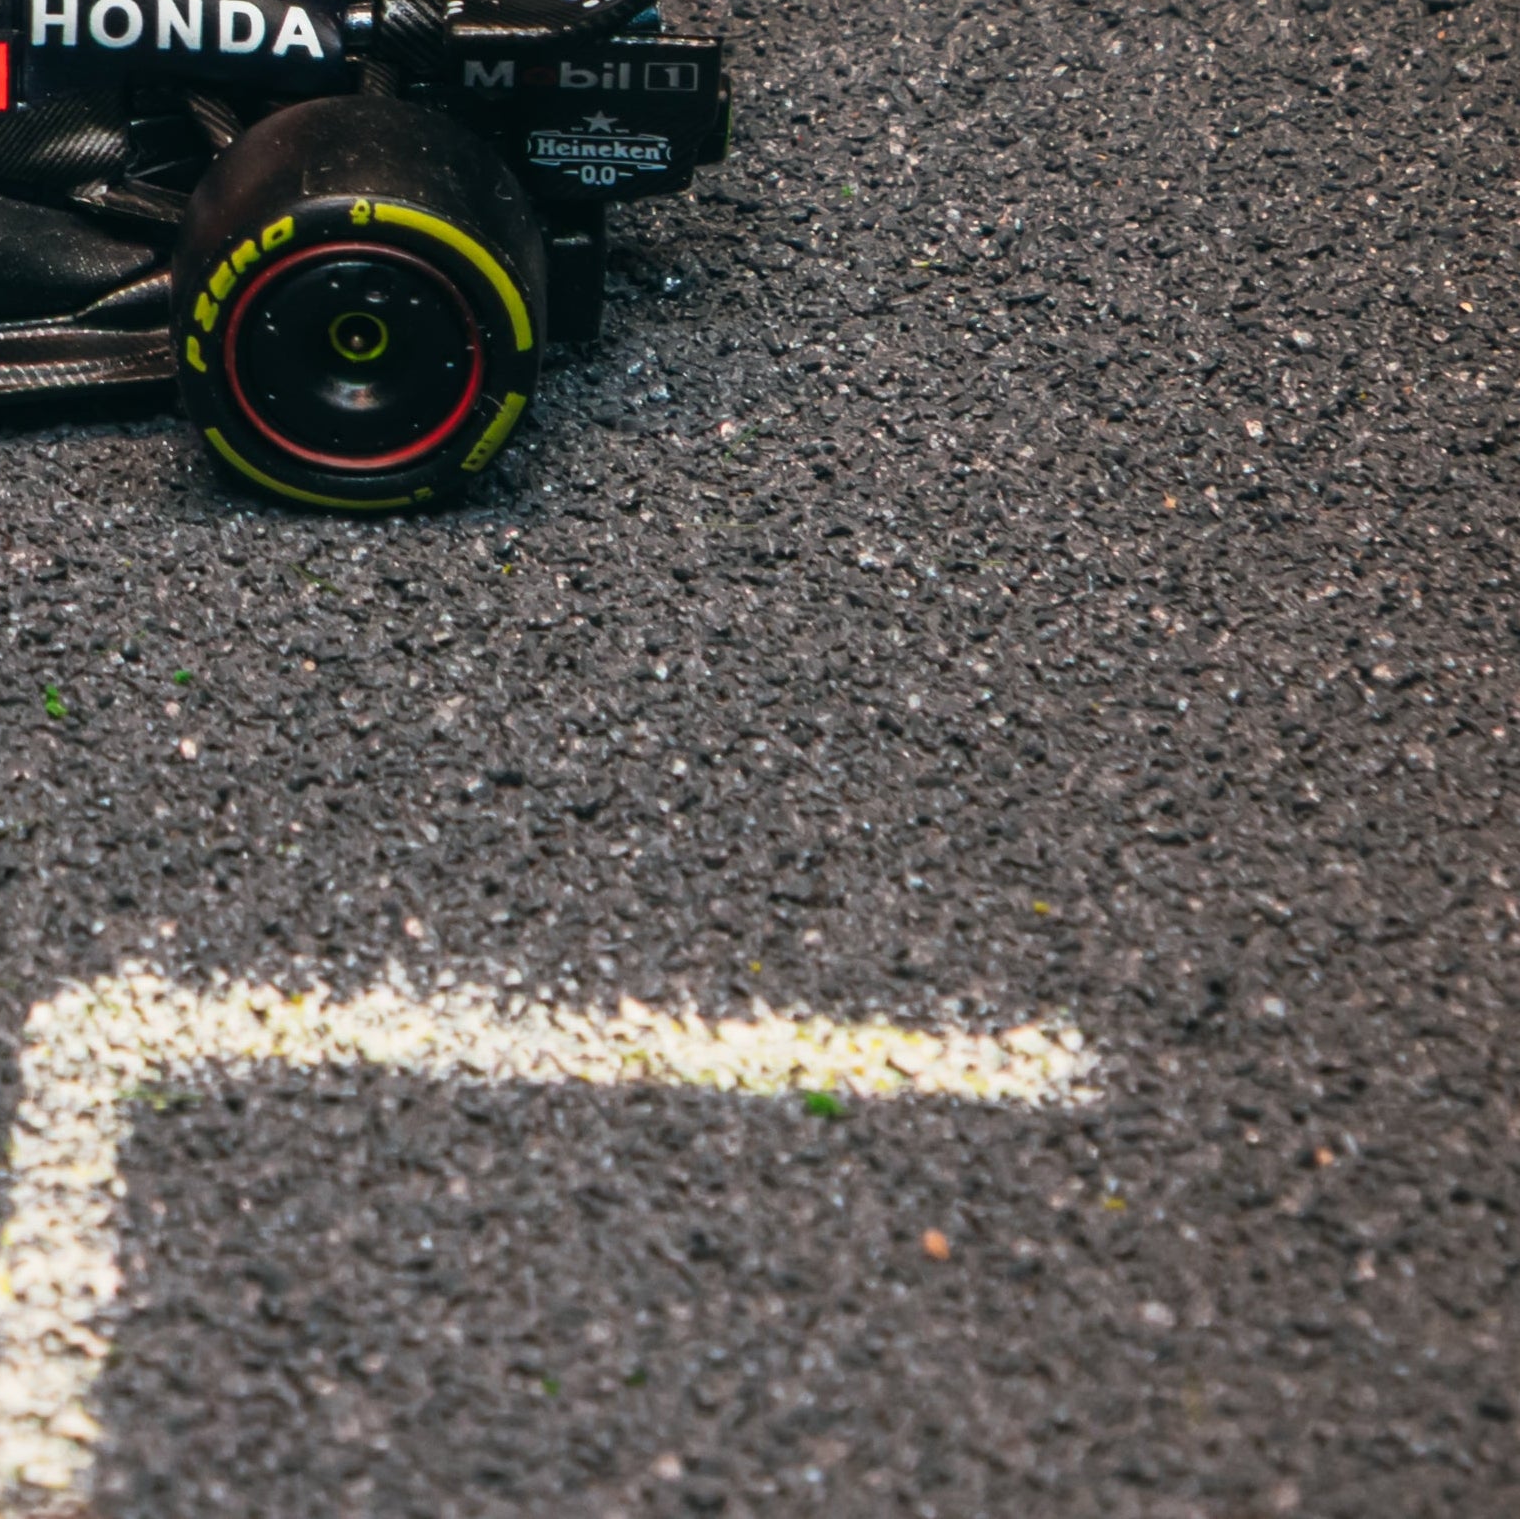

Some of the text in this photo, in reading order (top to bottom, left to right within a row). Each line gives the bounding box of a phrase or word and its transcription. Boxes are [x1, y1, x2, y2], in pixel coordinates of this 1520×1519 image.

[464, 60, 631, 90] Mobil
[537, 138, 663, 161] Heineken
[581, 165, 617, 186] 0.0
